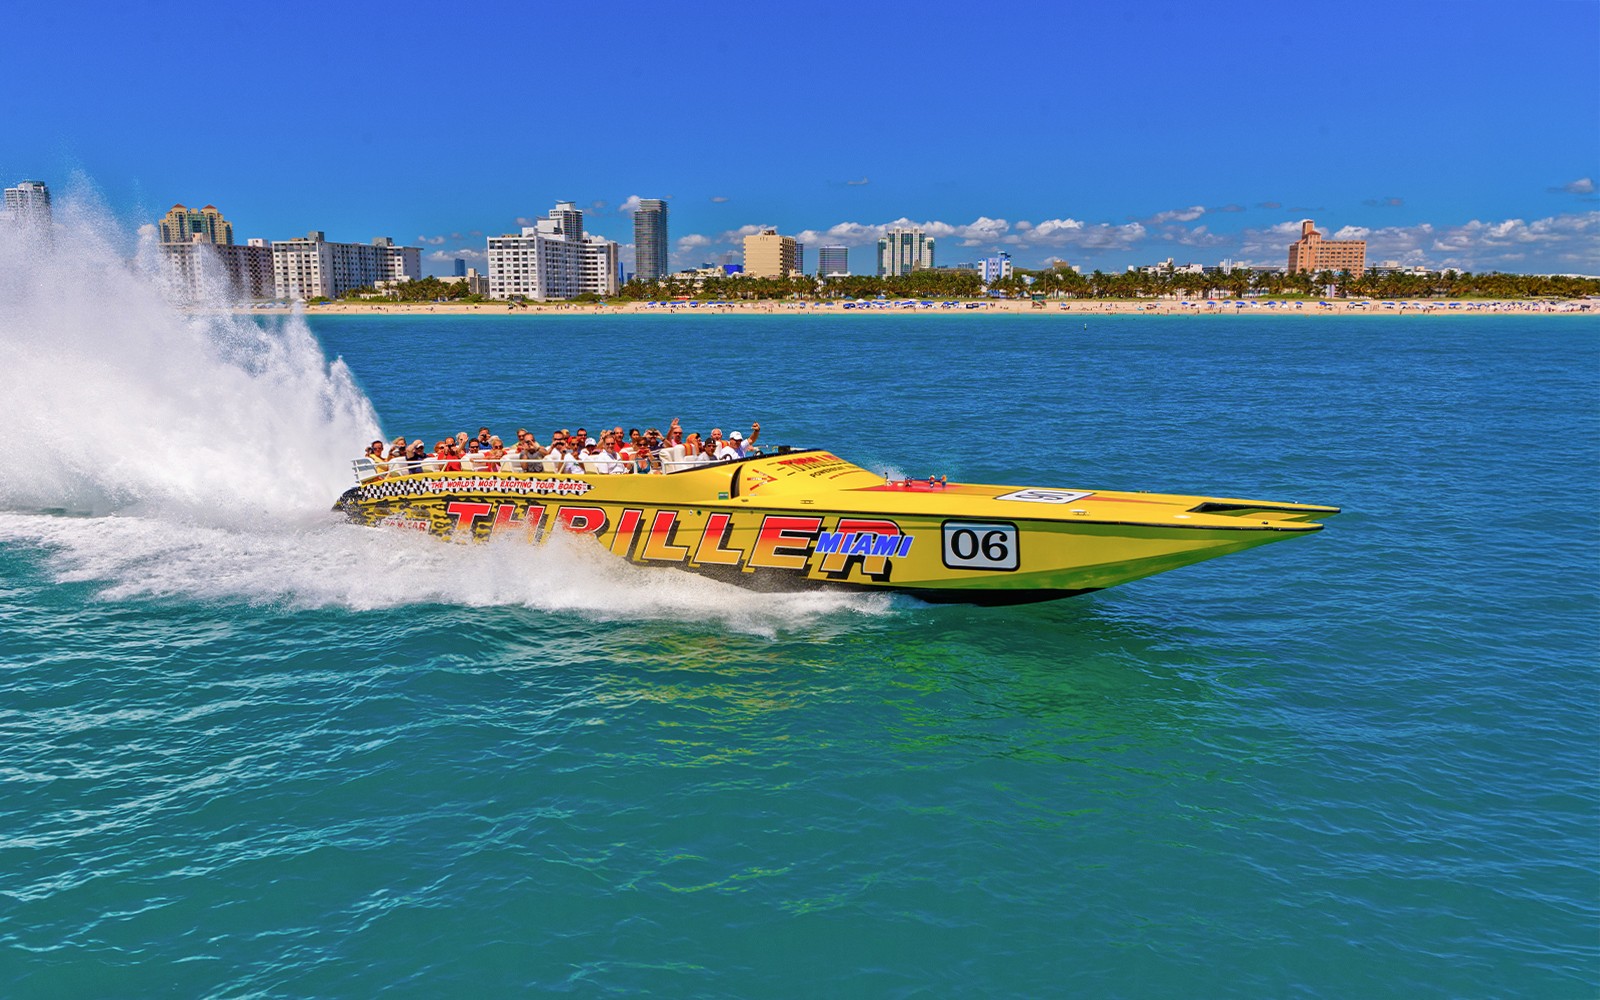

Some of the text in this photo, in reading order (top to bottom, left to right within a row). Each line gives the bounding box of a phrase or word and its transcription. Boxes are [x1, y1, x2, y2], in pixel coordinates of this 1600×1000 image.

[431, 480, 583, 491] THE WORLD'S MOST EXCITING TOUR BOATS
[446, 500, 902, 576] THRILLER
[814, 531, 915, 558] MIAMI
[950, 528, 1009, 562] 06
